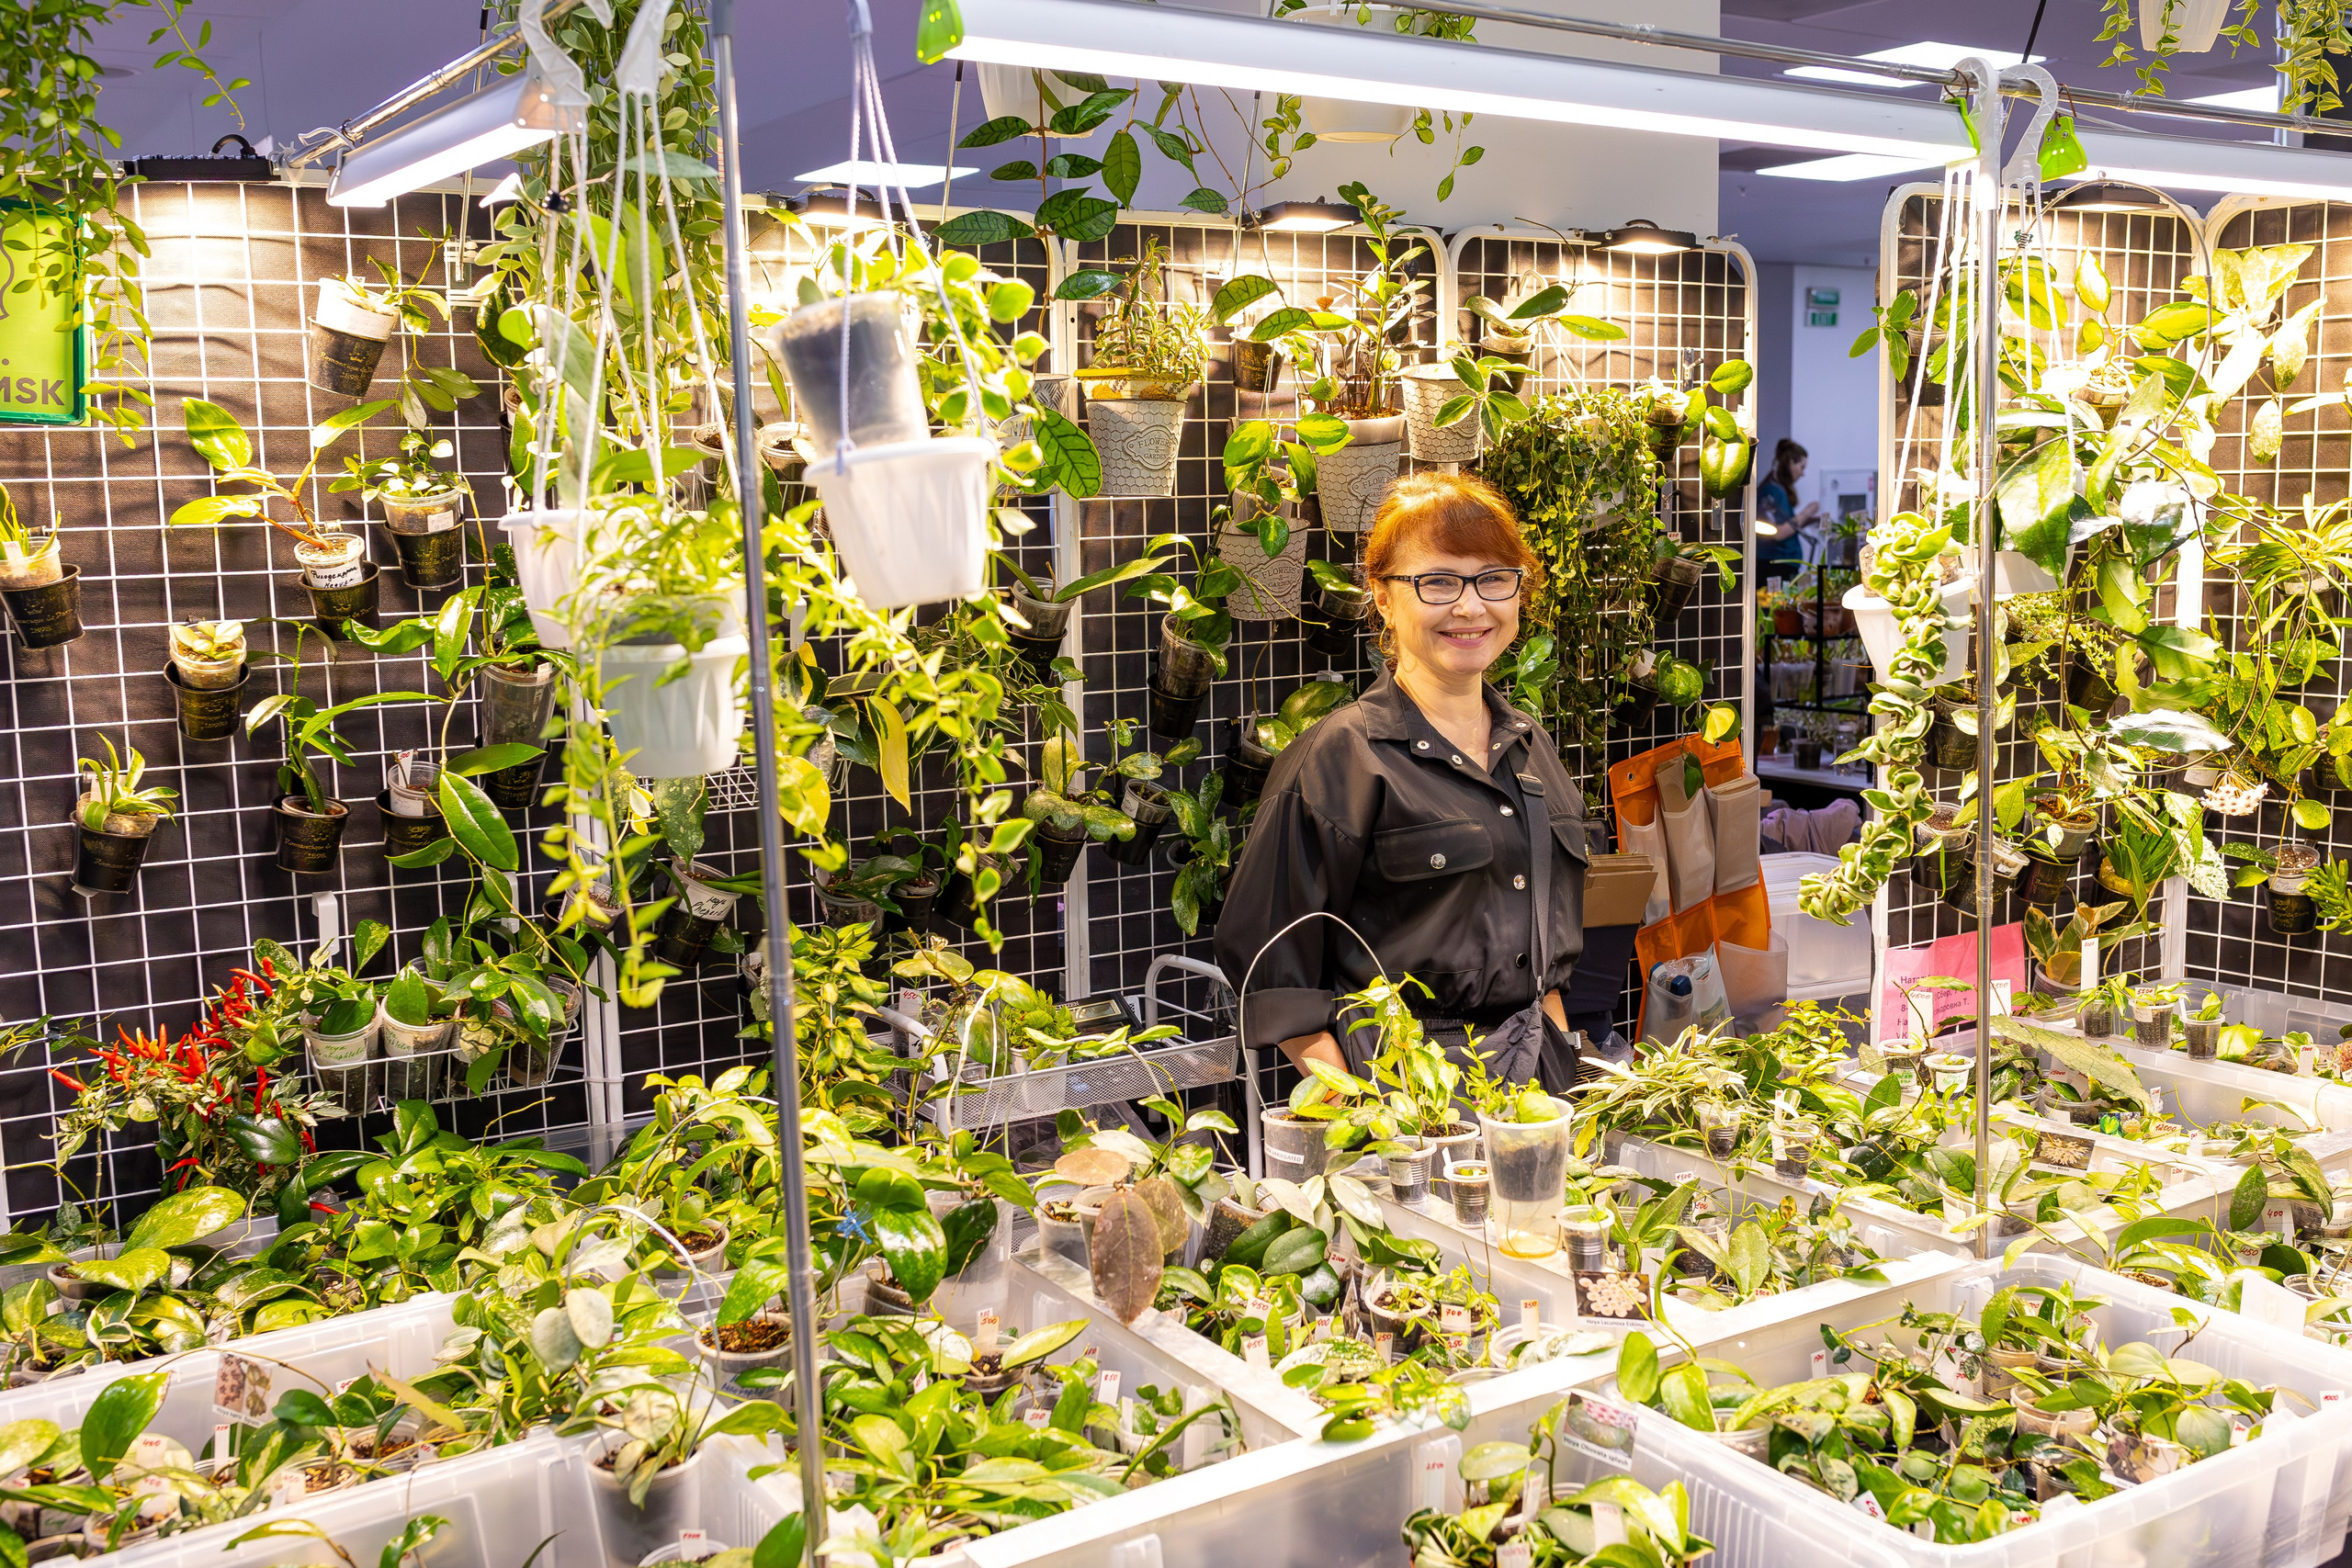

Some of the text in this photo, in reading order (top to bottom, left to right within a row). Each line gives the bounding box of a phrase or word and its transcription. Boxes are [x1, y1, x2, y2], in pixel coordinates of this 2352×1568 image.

[1262, 567, 1296, 580] FLOWERS
[1268, 581, 1292, 589] GARDEN
[2155, 1123, 2177, 1132] 12000
[2267, 1209, 2284, 1219] 400
[2241, 1247, 2259, 1257] 450
[1251, 1300, 1269, 1311] 450
[1524, 1301, 1537, 1309] 250
[1445, 1308, 1462, 1316] 700
[981, 1317, 997, 1325] 500
[1247, 1339, 1263, 1349] 450
[1029, 1413, 1046, 1421] 500
[1563, 1435, 1579, 1448] Hoya
[1580, 1442, 1607, 1459] Obovata
